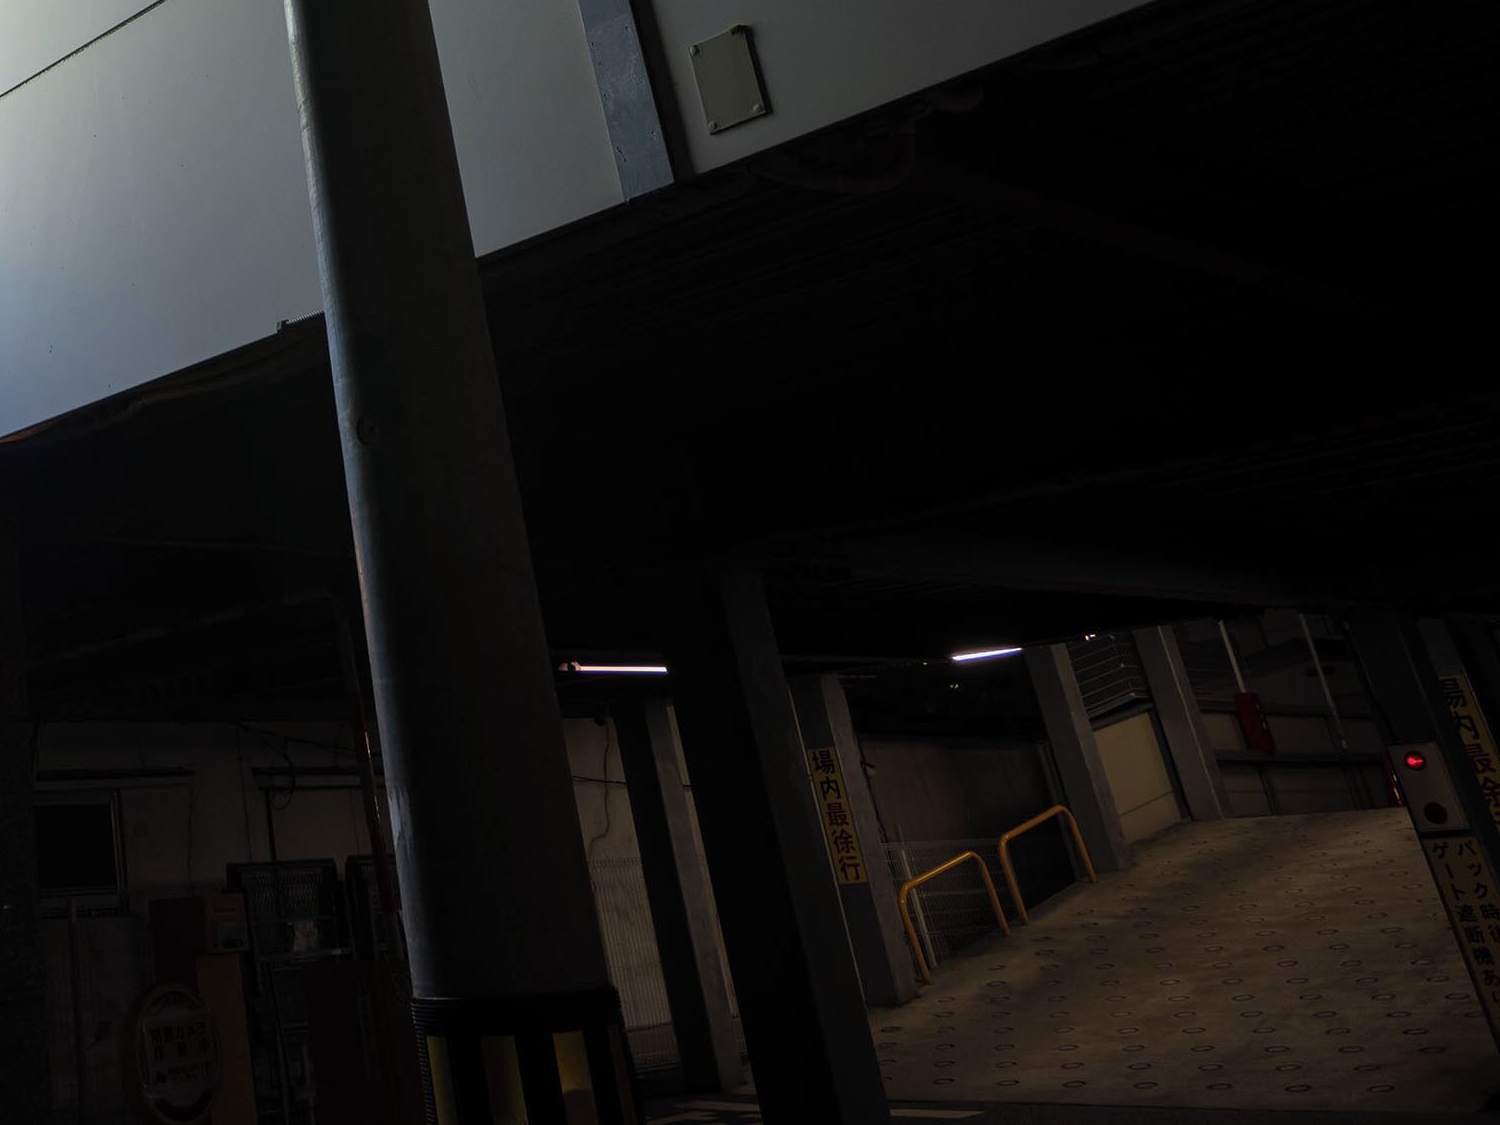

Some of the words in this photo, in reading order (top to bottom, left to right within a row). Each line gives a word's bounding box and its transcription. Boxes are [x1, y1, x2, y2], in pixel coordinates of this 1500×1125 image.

[812, 749, 861, 881] 場内最徐行
